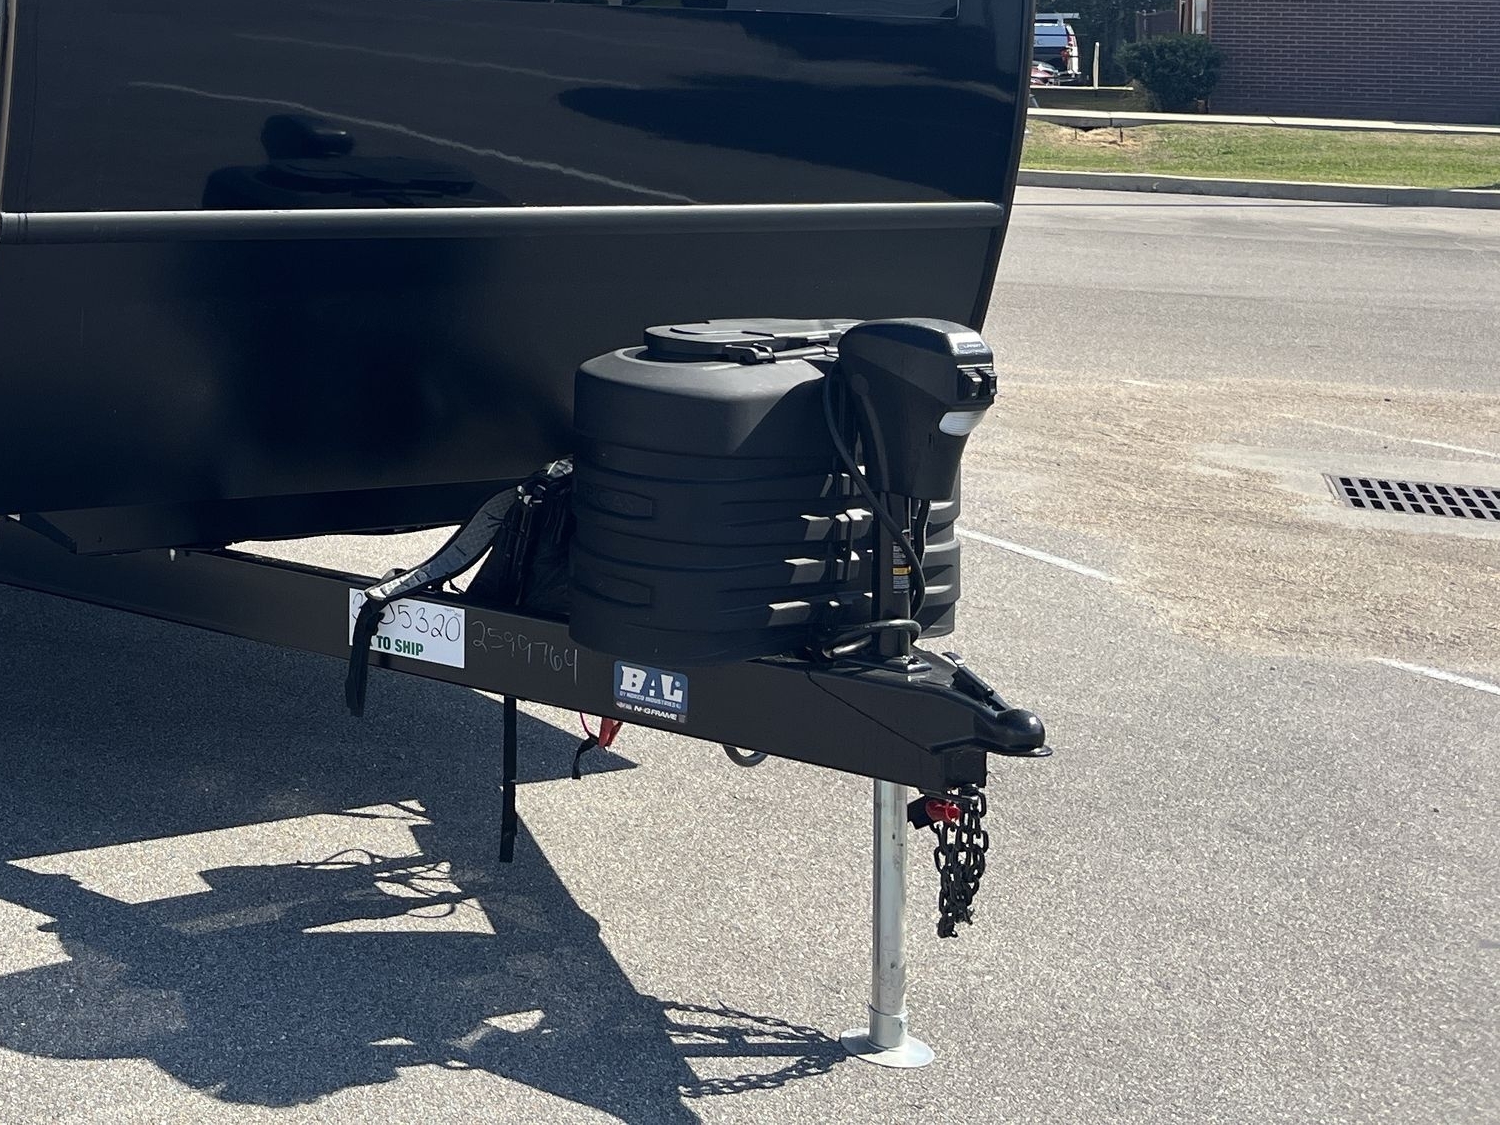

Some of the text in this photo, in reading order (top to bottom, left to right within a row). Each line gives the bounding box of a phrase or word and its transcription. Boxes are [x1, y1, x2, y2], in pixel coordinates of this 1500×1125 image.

[376, 635, 391, 650] TO
[394, 638, 424, 656] SHIP
[620, 665, 683, 703] BAL
